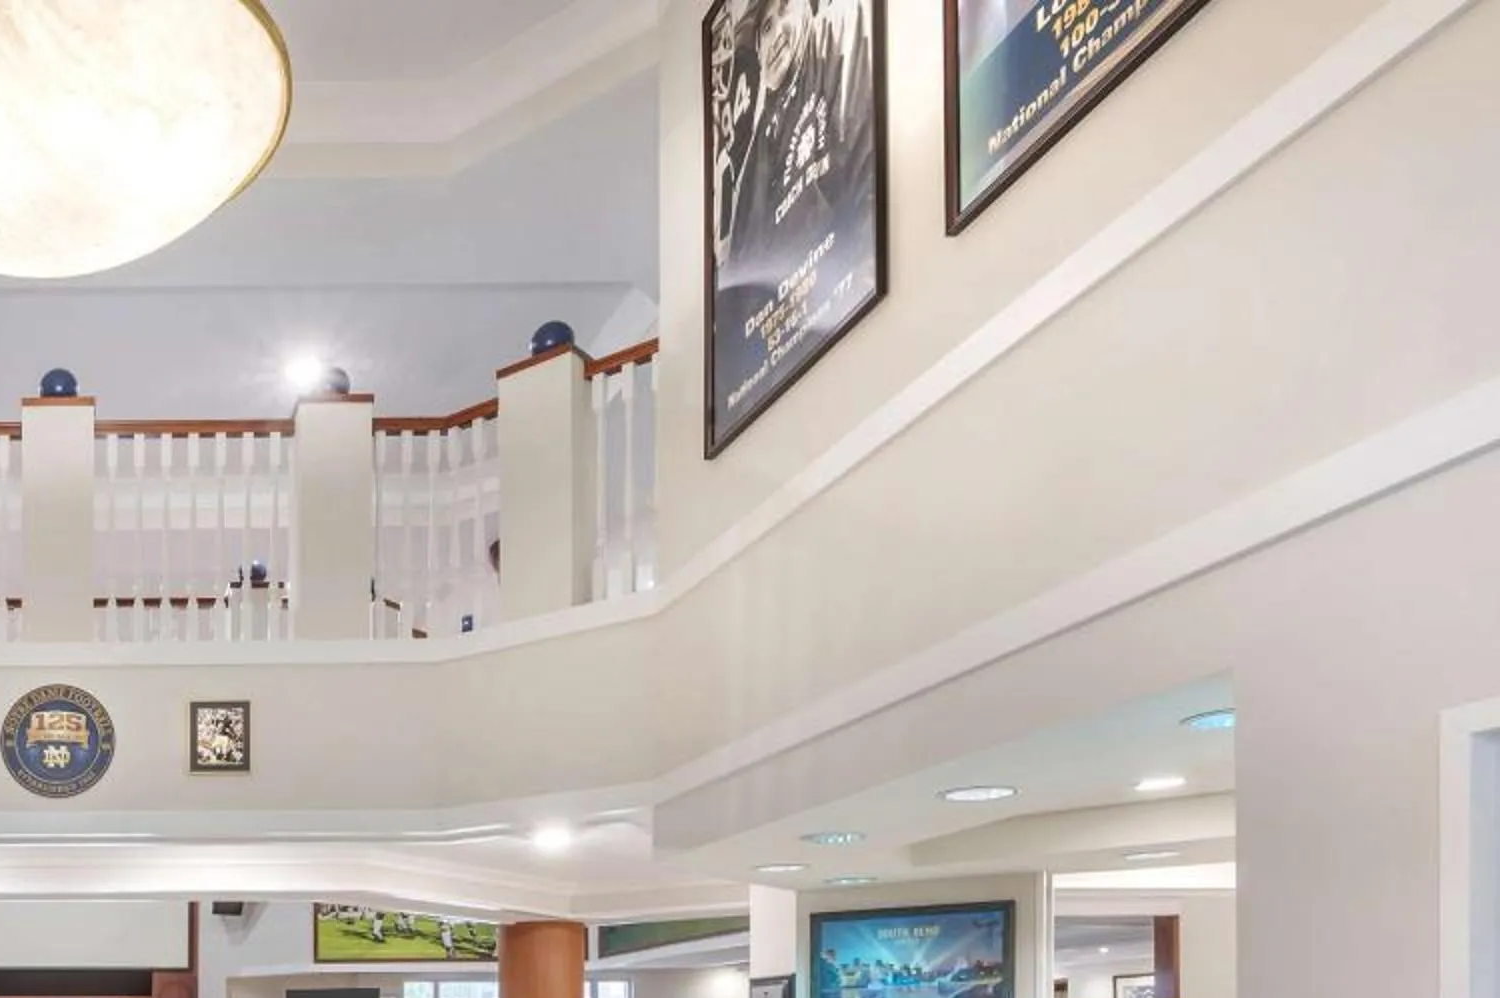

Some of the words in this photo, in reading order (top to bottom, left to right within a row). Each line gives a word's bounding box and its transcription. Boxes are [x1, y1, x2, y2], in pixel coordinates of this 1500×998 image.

[988, 65, 1067, 155] National
[745, 300, 773, 339] Dan
[777, 232, 835, 301] Devine
[35, 713, 82, 731] 125
